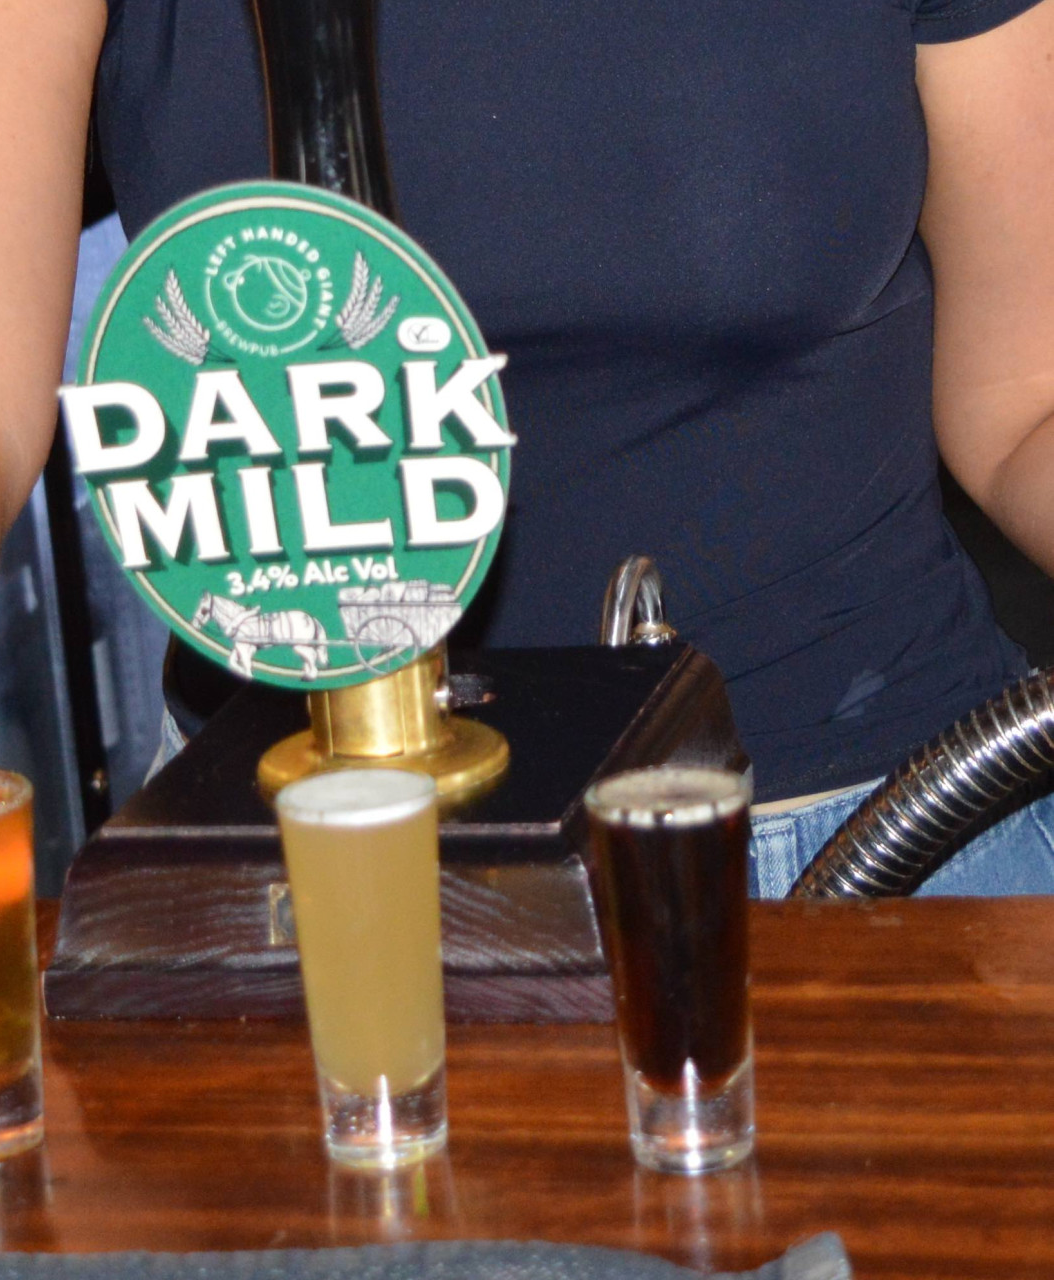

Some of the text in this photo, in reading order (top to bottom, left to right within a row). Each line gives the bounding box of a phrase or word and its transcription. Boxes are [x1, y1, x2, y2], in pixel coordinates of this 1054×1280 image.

[205, 226, 334, 330] LEFT HANDED GIANT
[216, 321, 279, 358] BREWPUB
[58, 353, 519, 476] DARK
[105, 455, 506, 570] MILD
[226, 556, 399, 596] 3.4% Alc Vol
